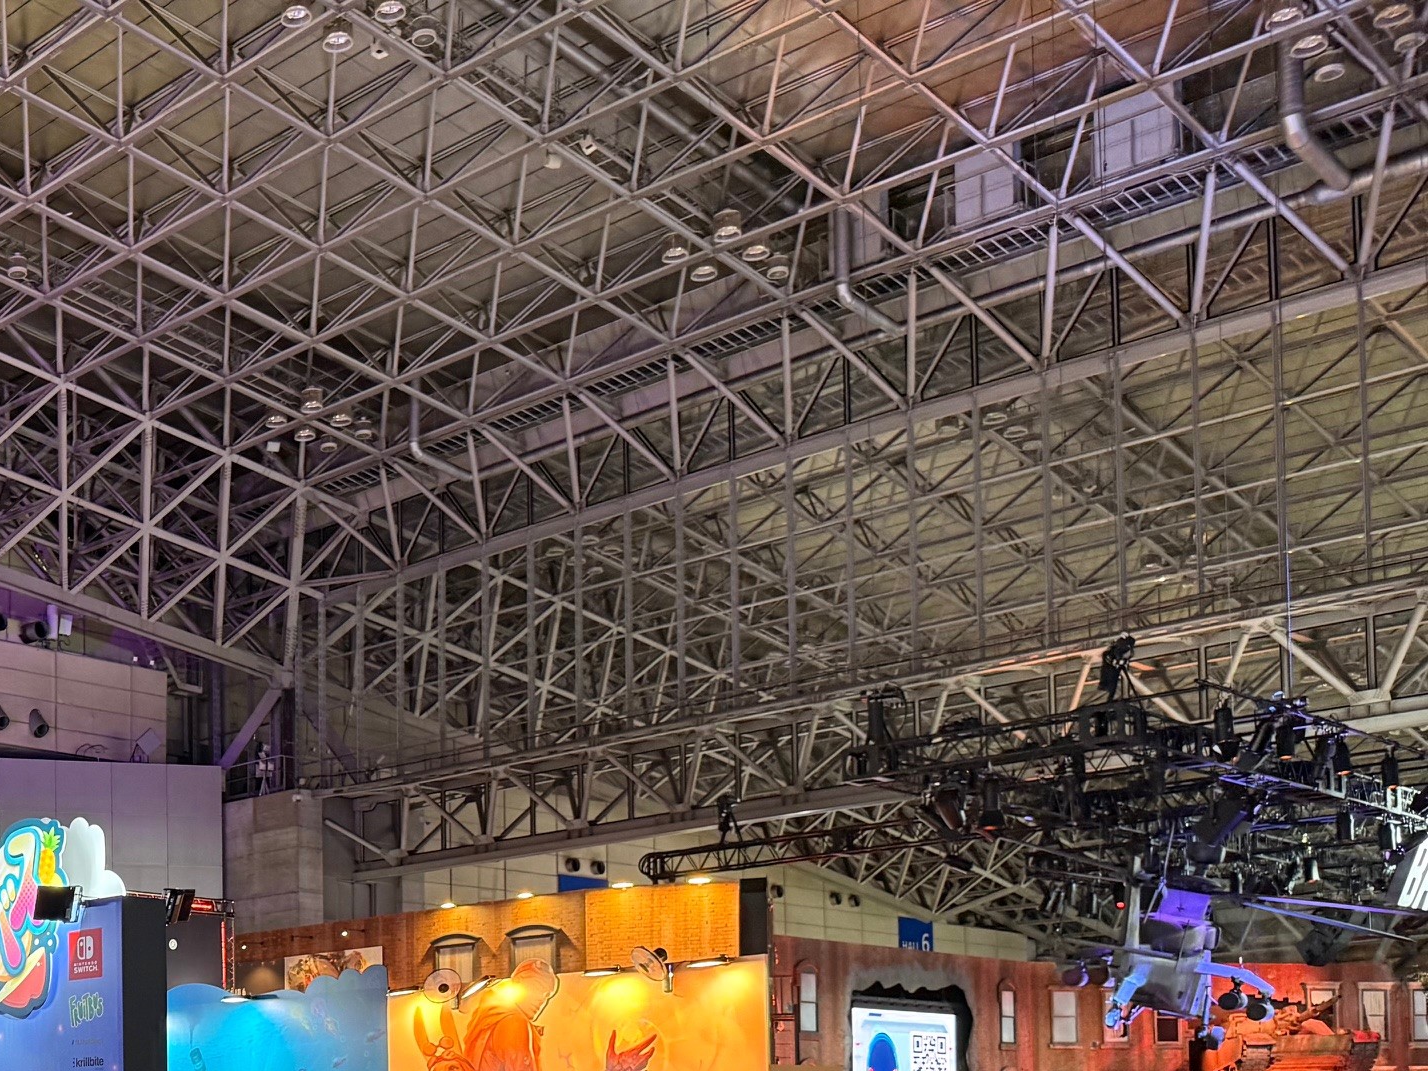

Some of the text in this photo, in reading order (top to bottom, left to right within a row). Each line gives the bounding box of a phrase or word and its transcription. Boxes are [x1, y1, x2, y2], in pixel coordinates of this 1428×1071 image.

[921, 933, 930, 951] 6
[73, 965, 98, 974] SWITCH
[75, 1056, 104, 1067] krillbite
